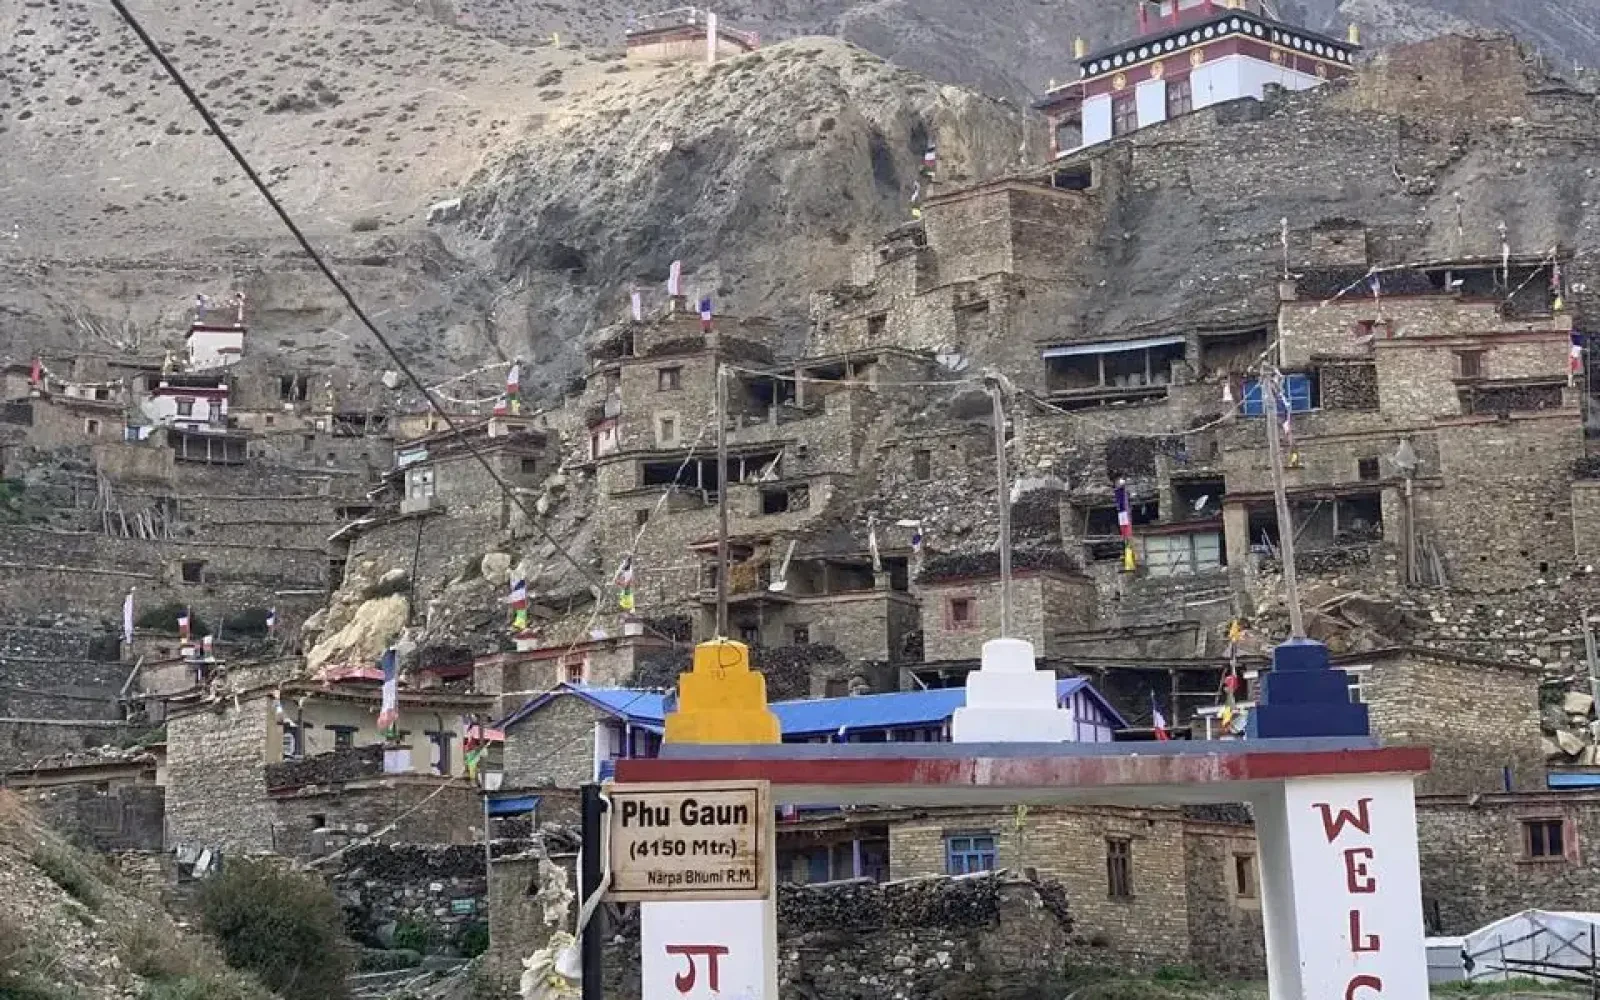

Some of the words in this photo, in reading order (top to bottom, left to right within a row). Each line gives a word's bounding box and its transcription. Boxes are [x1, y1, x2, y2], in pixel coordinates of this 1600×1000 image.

[622, 801, 670, 827] Phu
[680, 798, 748, 826] Gaun
[629, 840, 686, 860] (4150
[692, 838, 737, 858] Mtr.)
[648, 871, 682, 887] Narpa
[685, 869, 723, 885] Bhumi
[726, 869, 754, 884] R.M.
